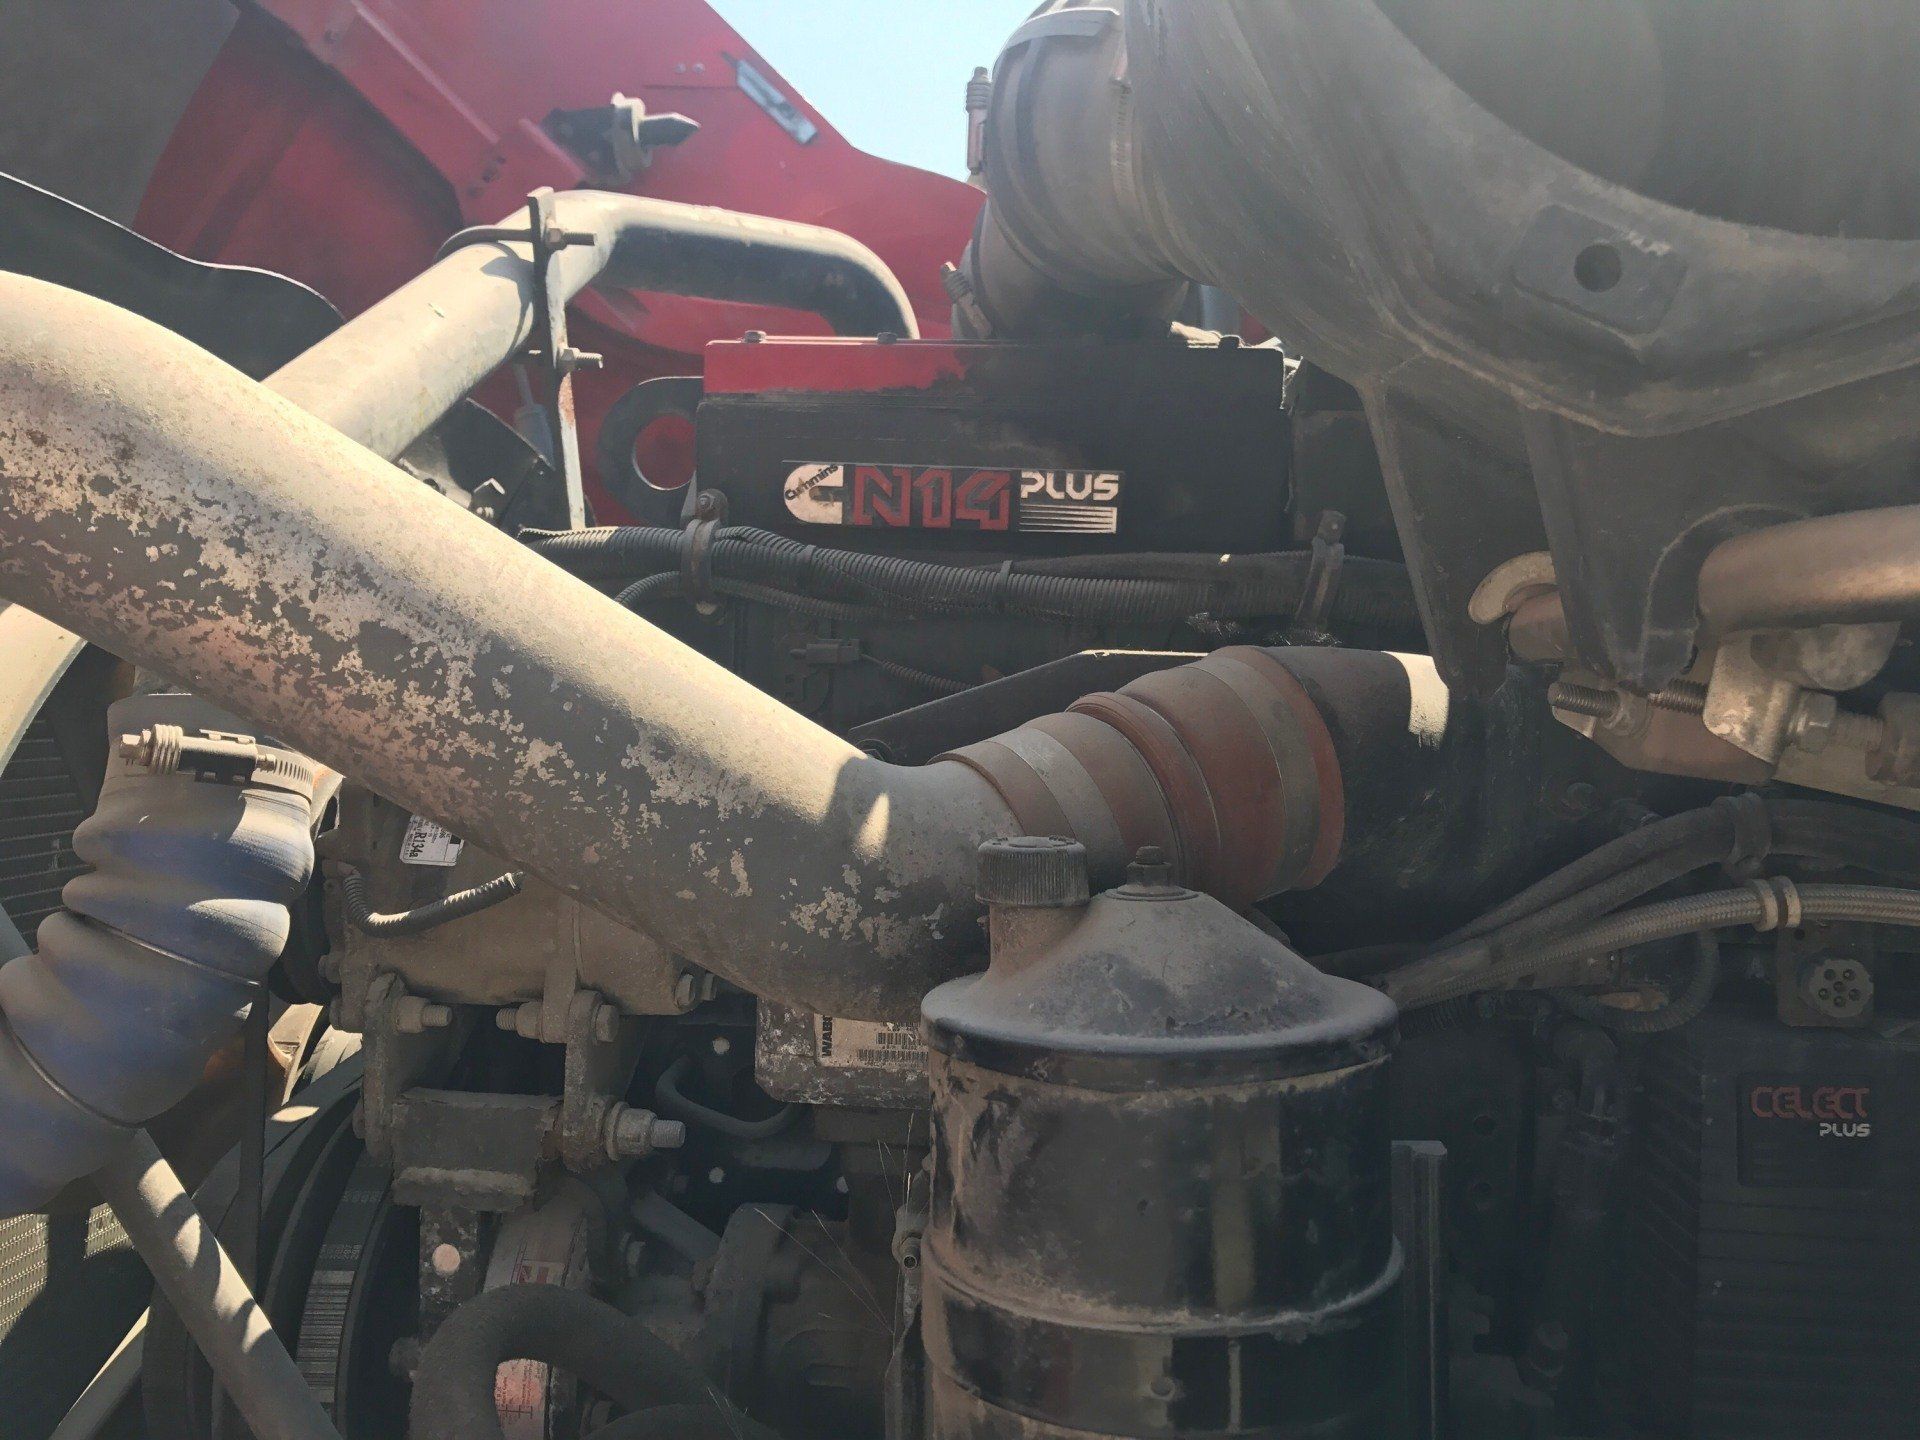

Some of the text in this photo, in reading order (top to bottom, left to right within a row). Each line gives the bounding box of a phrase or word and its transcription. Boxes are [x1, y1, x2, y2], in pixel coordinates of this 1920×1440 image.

[784, 462, 839, 502] Cummins
[853, 466, 1120, 531] N14 PLUS
[408, 831, 427, 858] R134a
[1751, 1086, 1870, 1119] CELECT
[1819, 1122, 1871, 1138] PLUS
